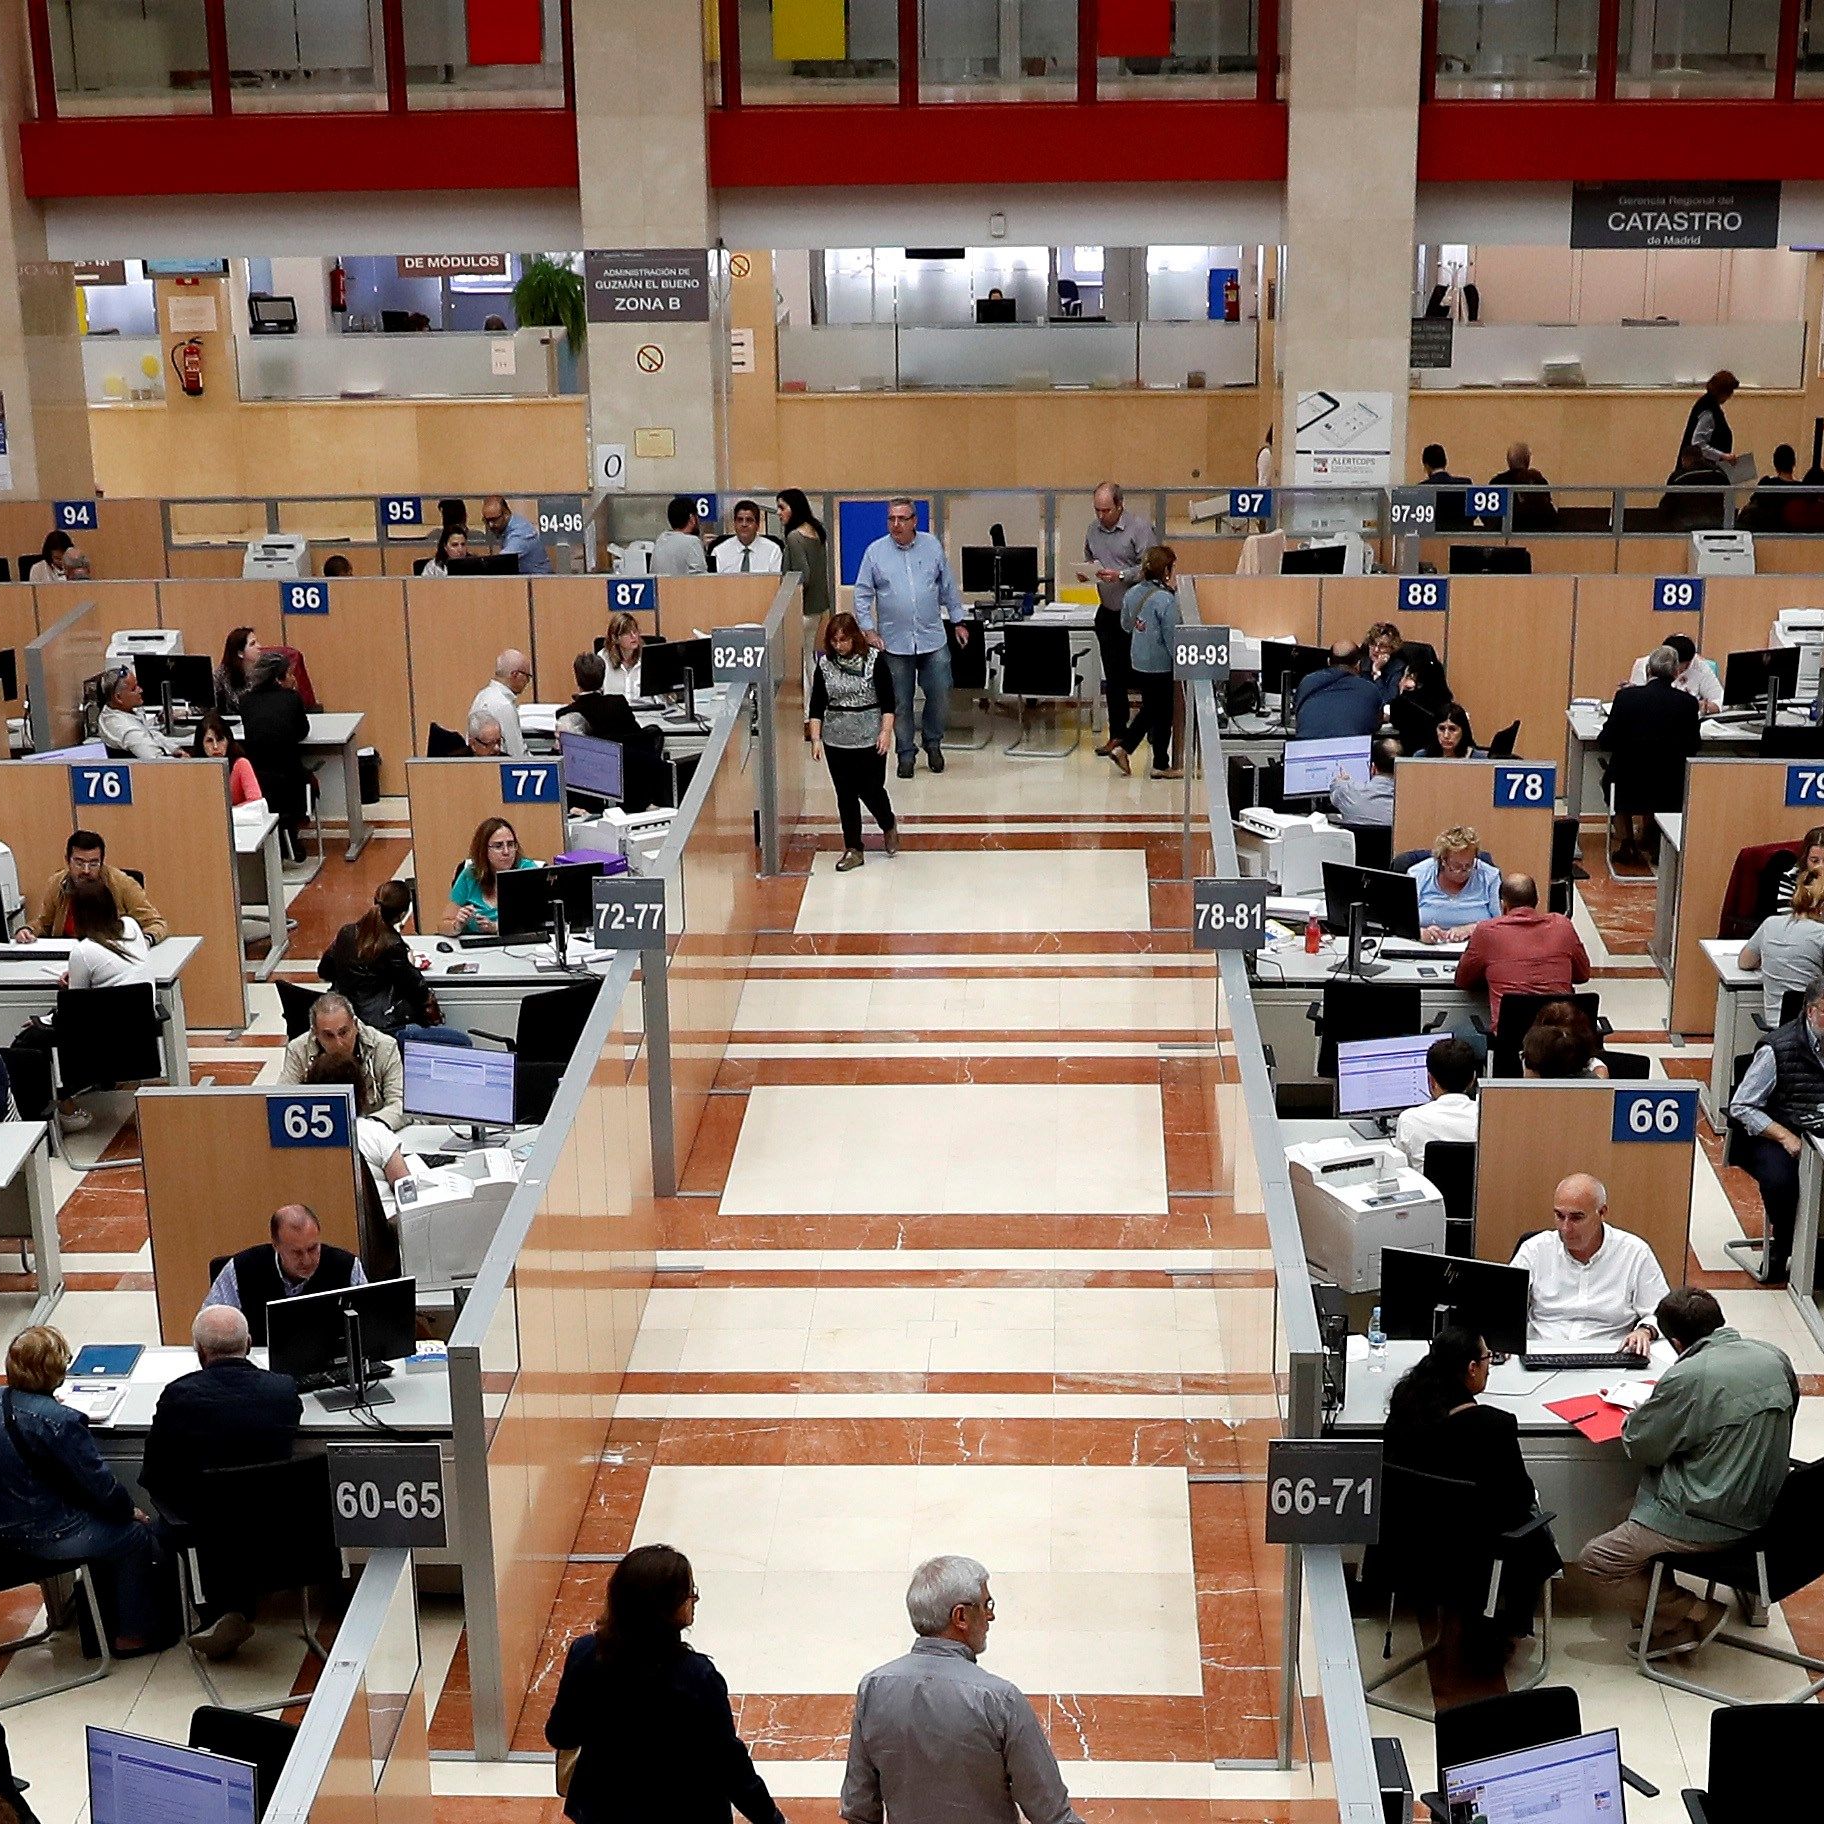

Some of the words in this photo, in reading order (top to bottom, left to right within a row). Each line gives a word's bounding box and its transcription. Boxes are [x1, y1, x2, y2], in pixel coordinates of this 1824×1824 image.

[1608, 212, 1742, 232] CATASTRO
[1647, 236, 1661, 245] de
[1664, 236, 1701, 245] Madrid
[404, 257, 424, 269] DE
[427, 255, 499, 268] MÓDULOS
[603, 268, 677, 276] ADMINISTRACIÓN
[595, 278, 643, 289] GUZMÁN
[645, 280, 658, 288] EL
[661, 279, 700, 288] BUENO
[614, 297, 664, 311] ZONA
[669, 298, 681, 310] B
[389, 501, 414, 520] 95
[697, 498, 708, 516] 6
[1238, 494, 1263, 512] 97
[1475, 492, 1499, 511] 98
[64, 506, 89, 524] 94
[540, 514, 582, 532] 94-96
[1392, 505, 1434, 522] 97-99
[292, 587, 320, 608] 86
[617, 584, 644, 605] 87
[1408, 584, 1436, 605] 88
[1663, 584, 1692, 605] 89
[714, 647, 764, 667] 82-87
[1177, 645, 1227, 665] 88-93
[84, 772, 120, 797] 76
[512, 770, 547, 795] 77
[1507, 774, 1542, 800] 78
[596, 904, 663, 929] 72-77
[1196, 904, 1261, 929] 78-81
[285, 1105, 333, 1138] 65
[1630, 1099, 1678, 1133] 66
[337, 1482, 441, 1518] 60-65
[1271, 1478, 1372, 1514] 66-71
